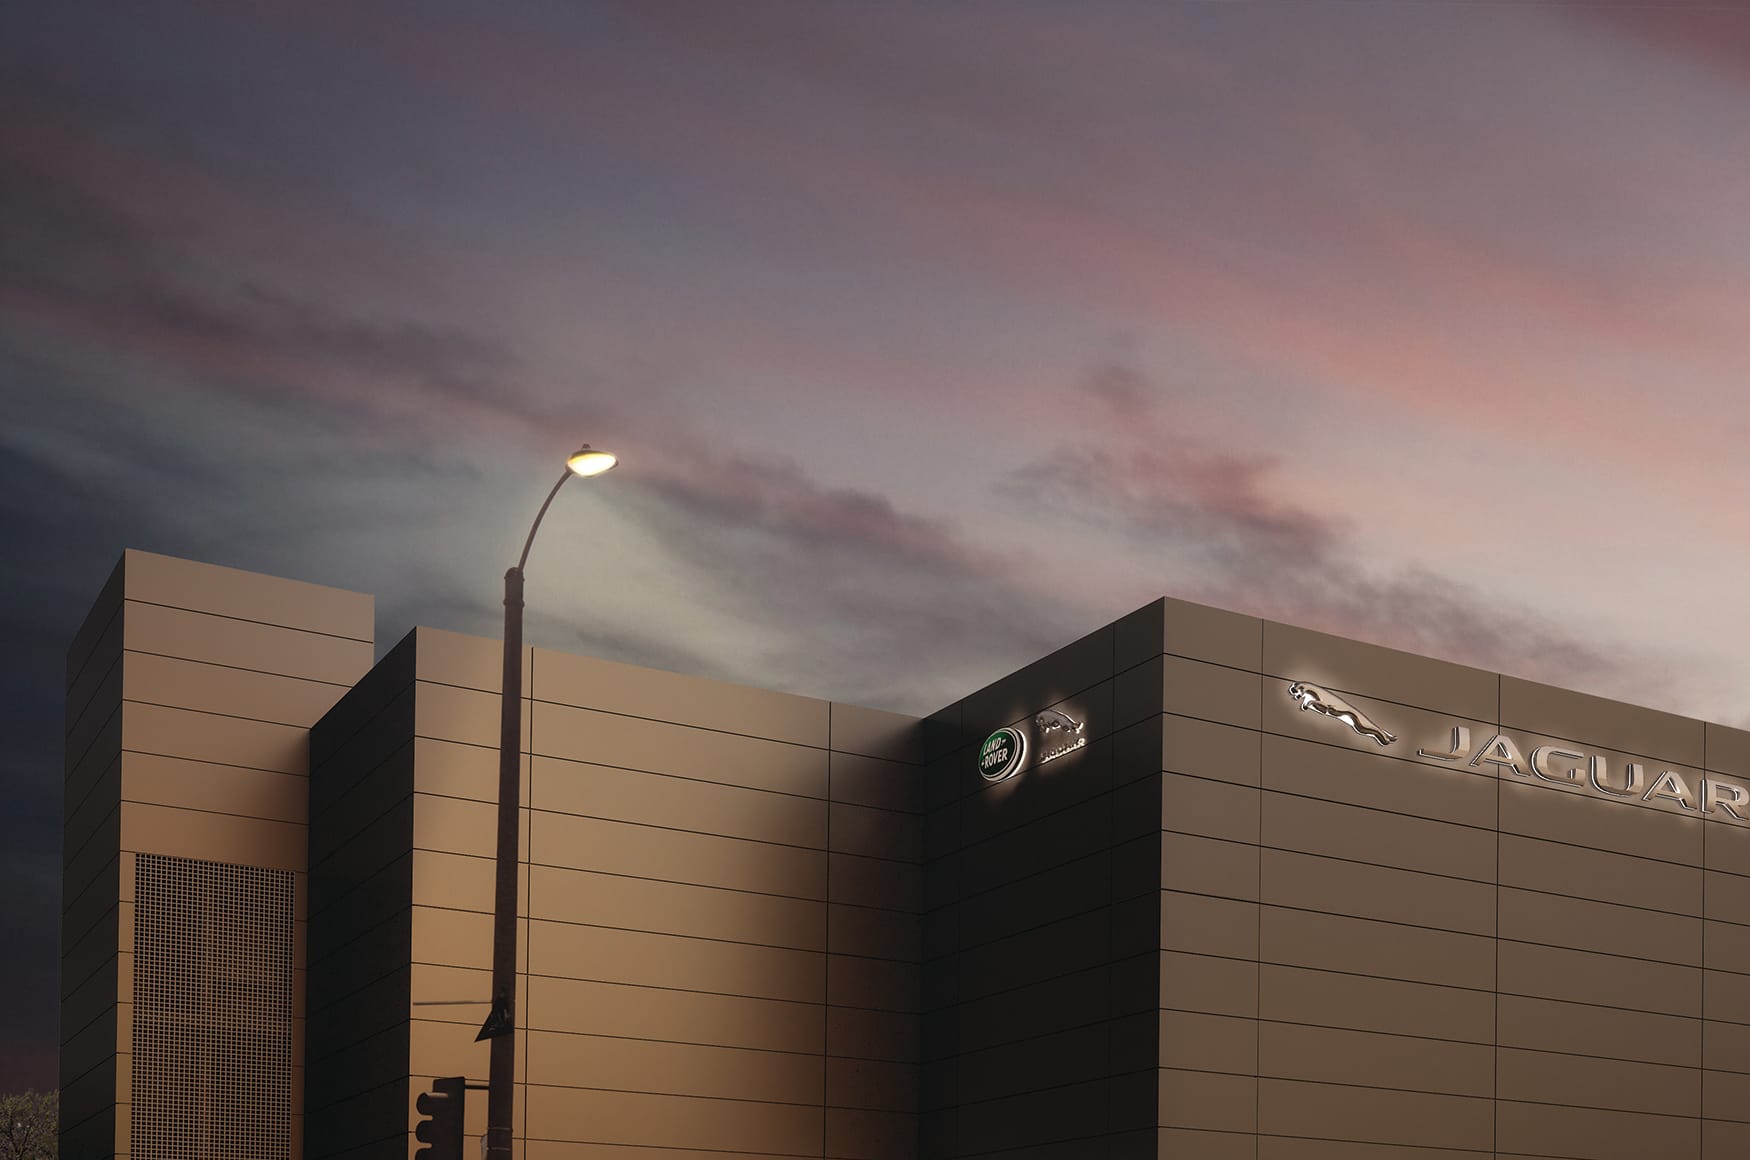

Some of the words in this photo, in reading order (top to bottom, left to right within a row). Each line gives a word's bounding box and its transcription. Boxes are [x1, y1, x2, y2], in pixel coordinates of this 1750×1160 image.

[982, 737, 1002, 755] LAND
[983, 748, 1009, 769] ROVER
[1417, 726, 1749, 821] JAGUAR
